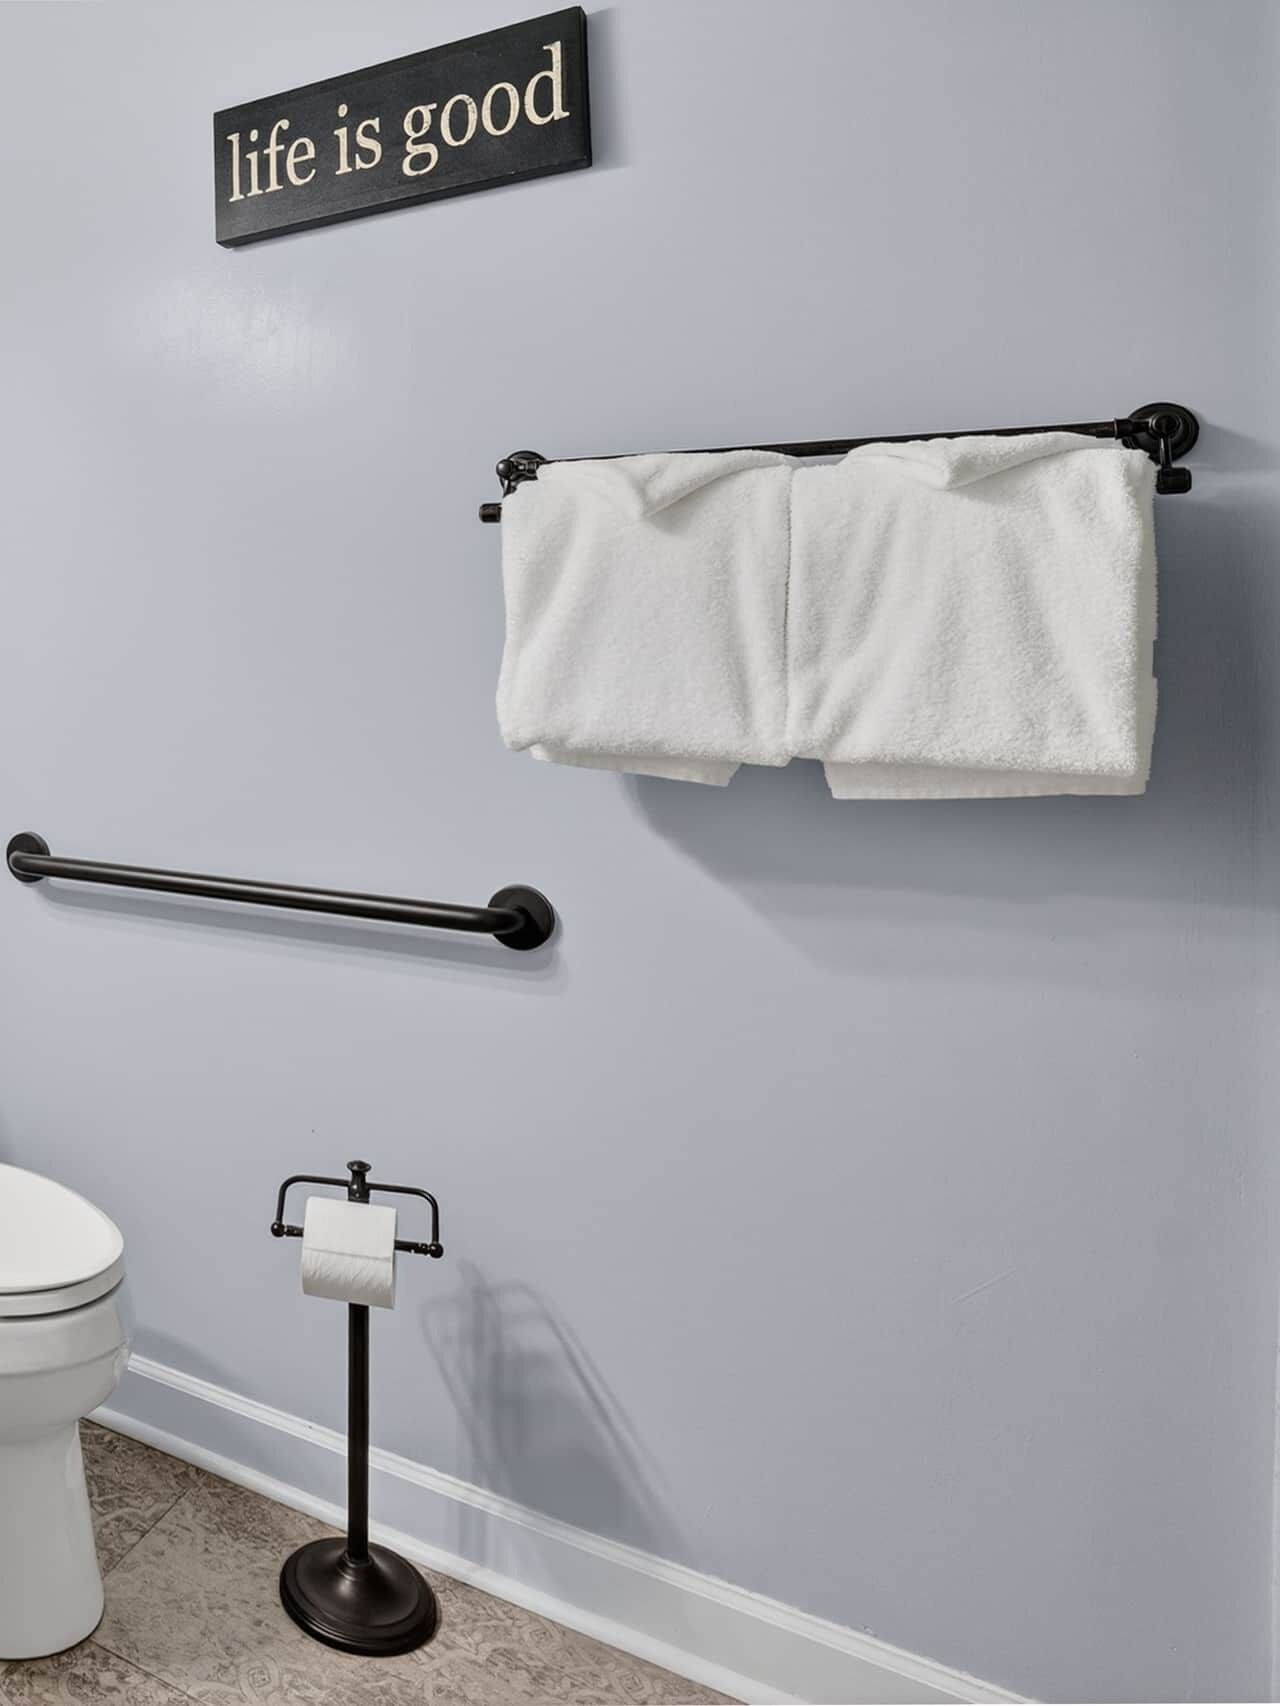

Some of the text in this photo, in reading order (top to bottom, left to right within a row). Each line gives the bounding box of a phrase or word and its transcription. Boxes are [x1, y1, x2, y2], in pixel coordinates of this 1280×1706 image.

[226, 41, 570, 202] life is good
